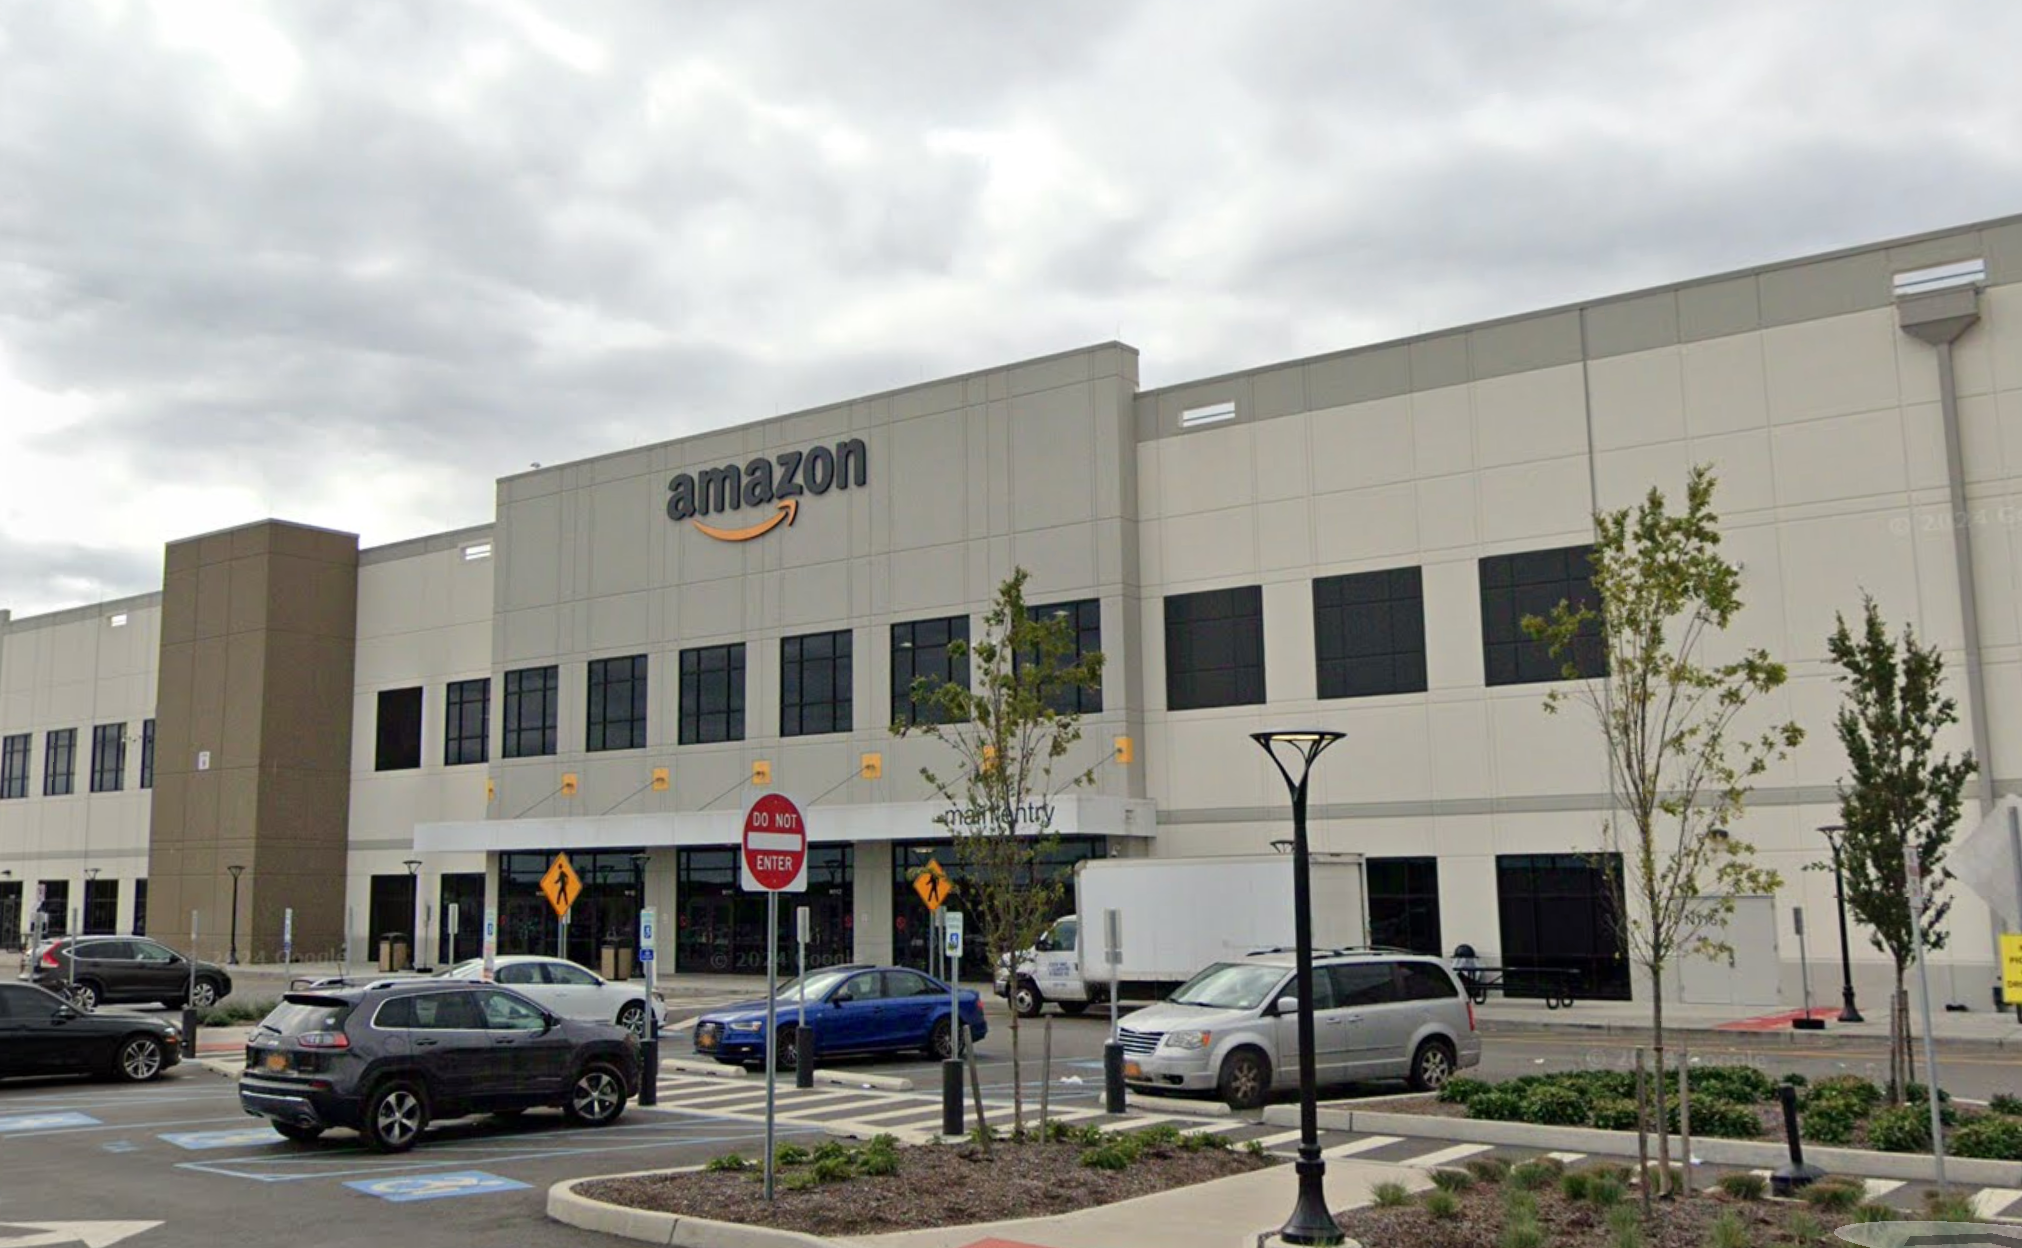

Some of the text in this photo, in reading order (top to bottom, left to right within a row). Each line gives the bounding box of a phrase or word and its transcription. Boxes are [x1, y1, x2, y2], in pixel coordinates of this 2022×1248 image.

[667, 438, 867, 521] amazon
[752, 811, 798, 829] DO NOT
[1001, 801, 1056, 829] entry
[757, 855, 793, 871] ENTER
